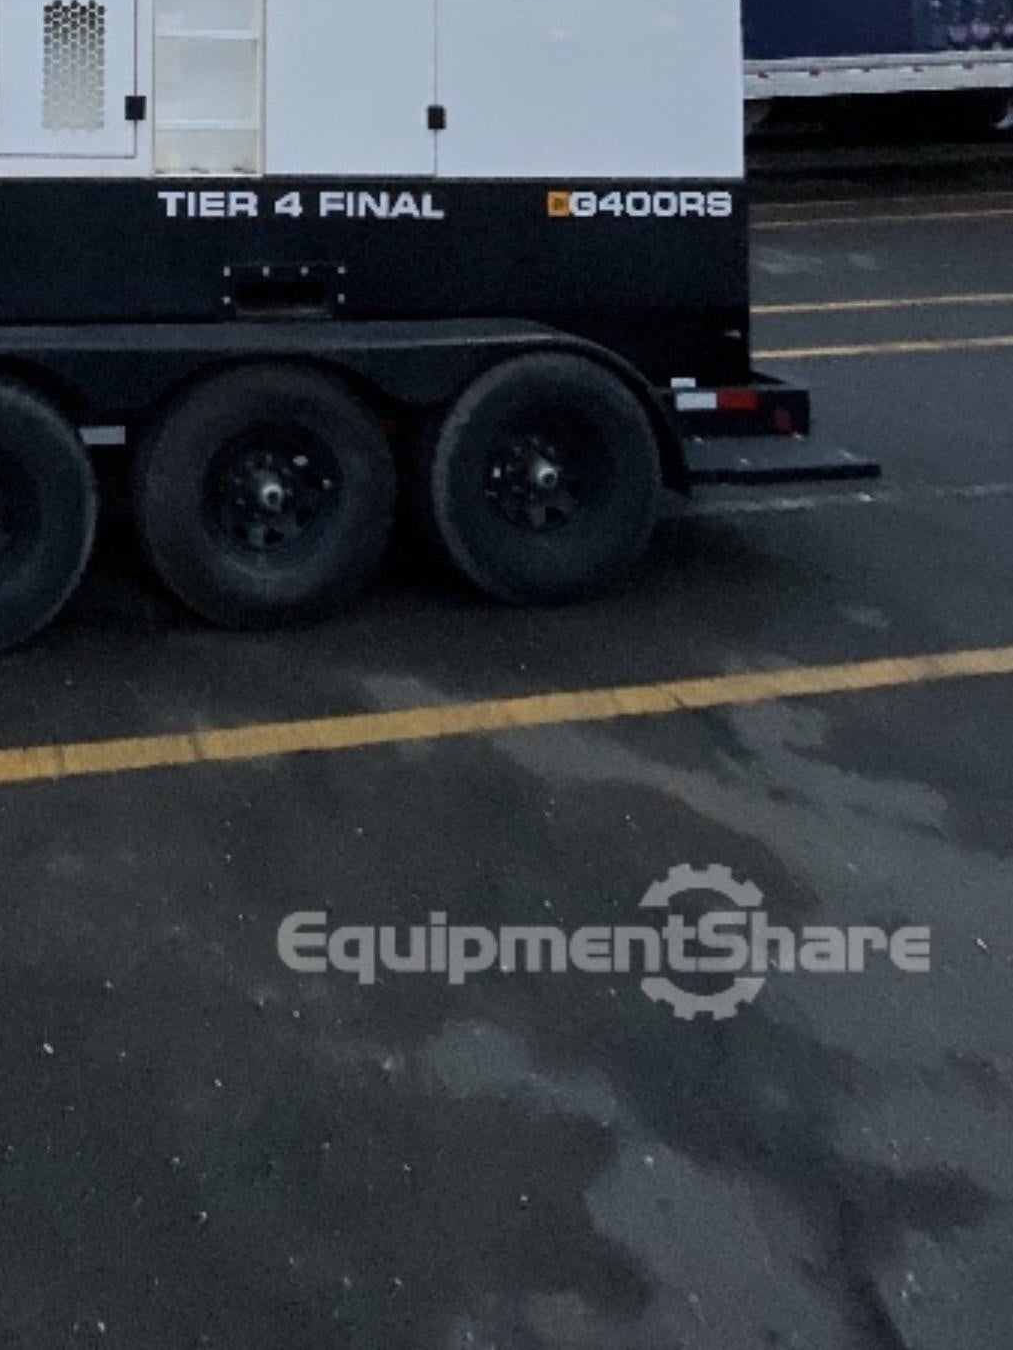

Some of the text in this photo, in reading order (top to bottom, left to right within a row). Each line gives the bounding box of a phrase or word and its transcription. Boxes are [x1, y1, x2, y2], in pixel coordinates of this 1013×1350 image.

[158, 191, 445, 219] TIER 4 FINAL
[570, 191, 732, 217] G400RS
